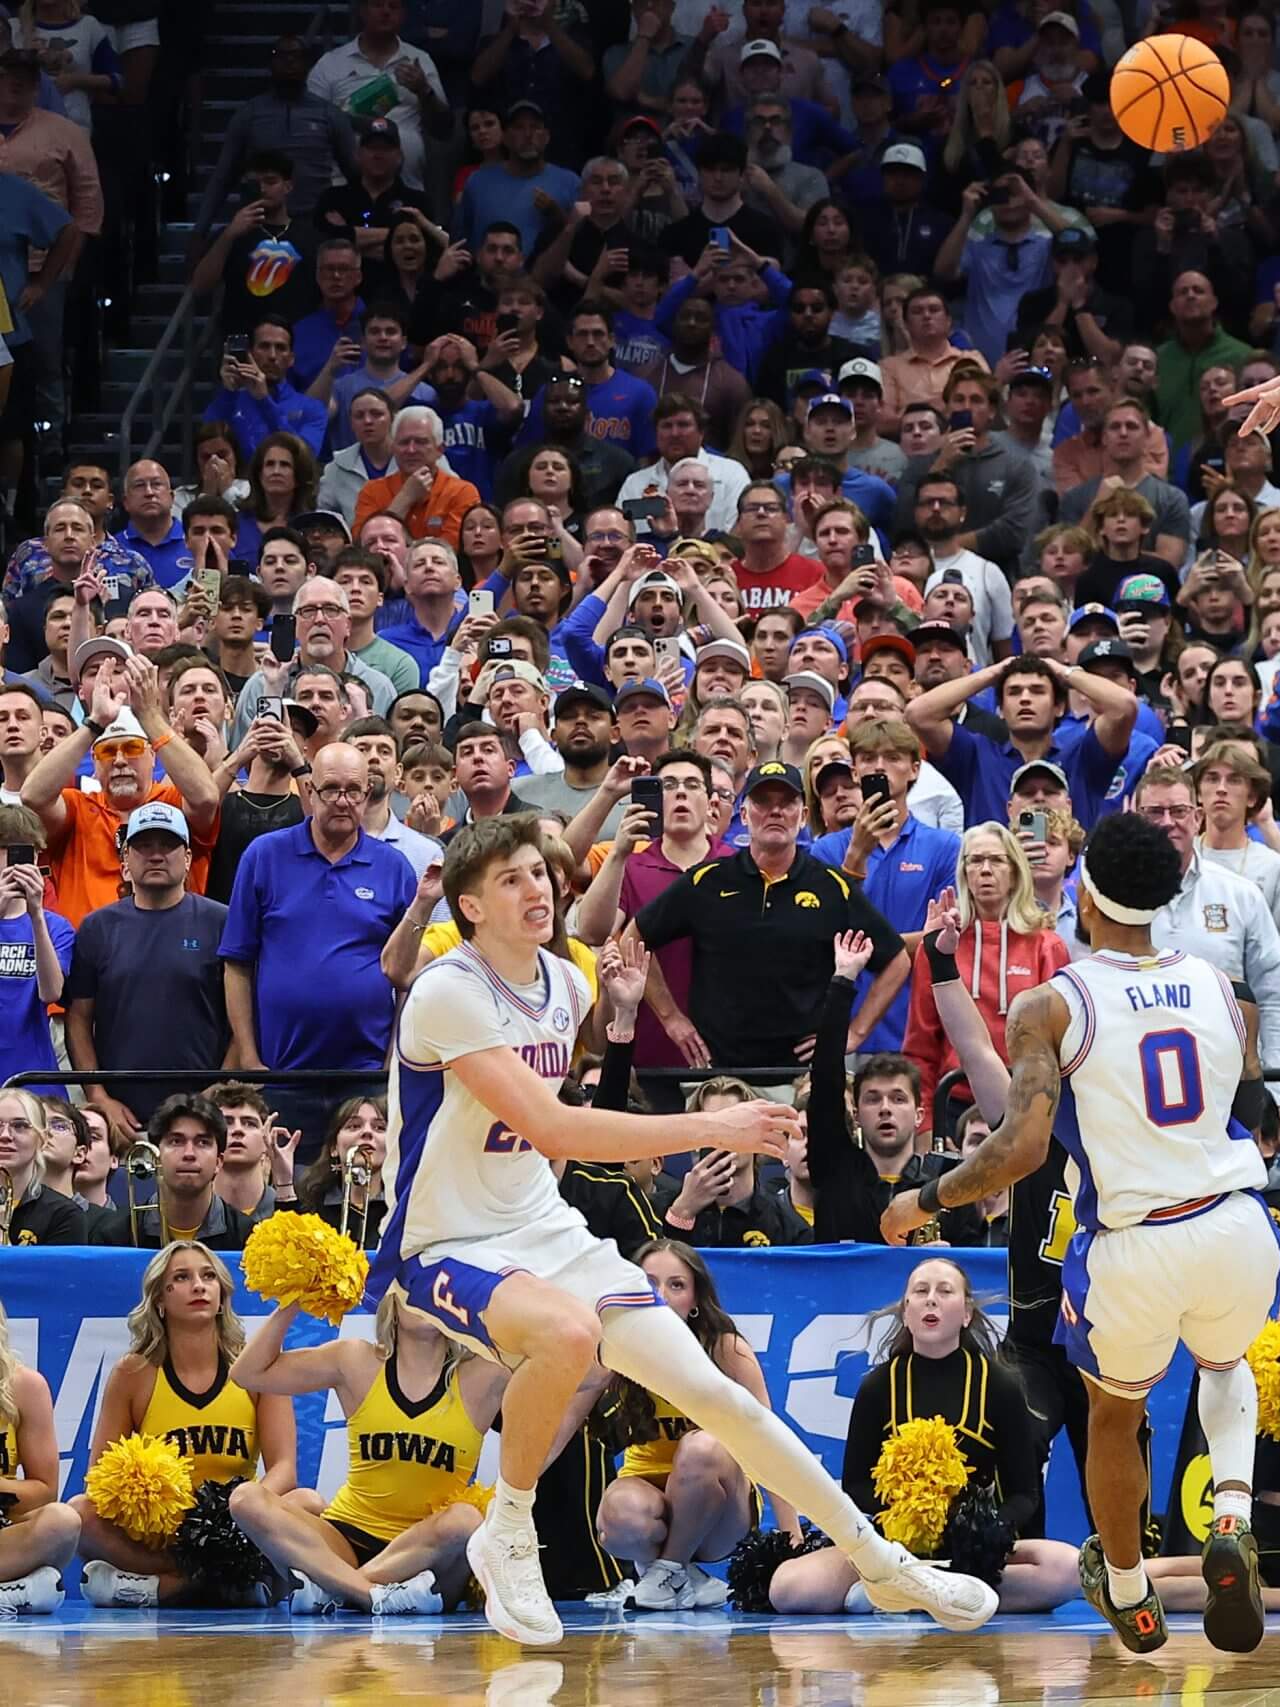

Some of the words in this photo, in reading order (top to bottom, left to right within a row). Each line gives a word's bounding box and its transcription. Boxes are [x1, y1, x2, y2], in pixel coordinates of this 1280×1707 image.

[444, 421, 486, 450] RIDA
[583, 415, 632, 441] tors
[0, 945, 27, 958] RCH
[0, 959, 37, 972] ADNES
[1125, 984, 1191, 1011] FLAND
[512, 1041, 569, 1078] ORIDA
[1138, 1026, 1205, 1128] 0
[433, 1269, 470, 1328] F
[165, 1425, 250, 1460] OWA
[359, 1432, 456, 1473] IOWA
